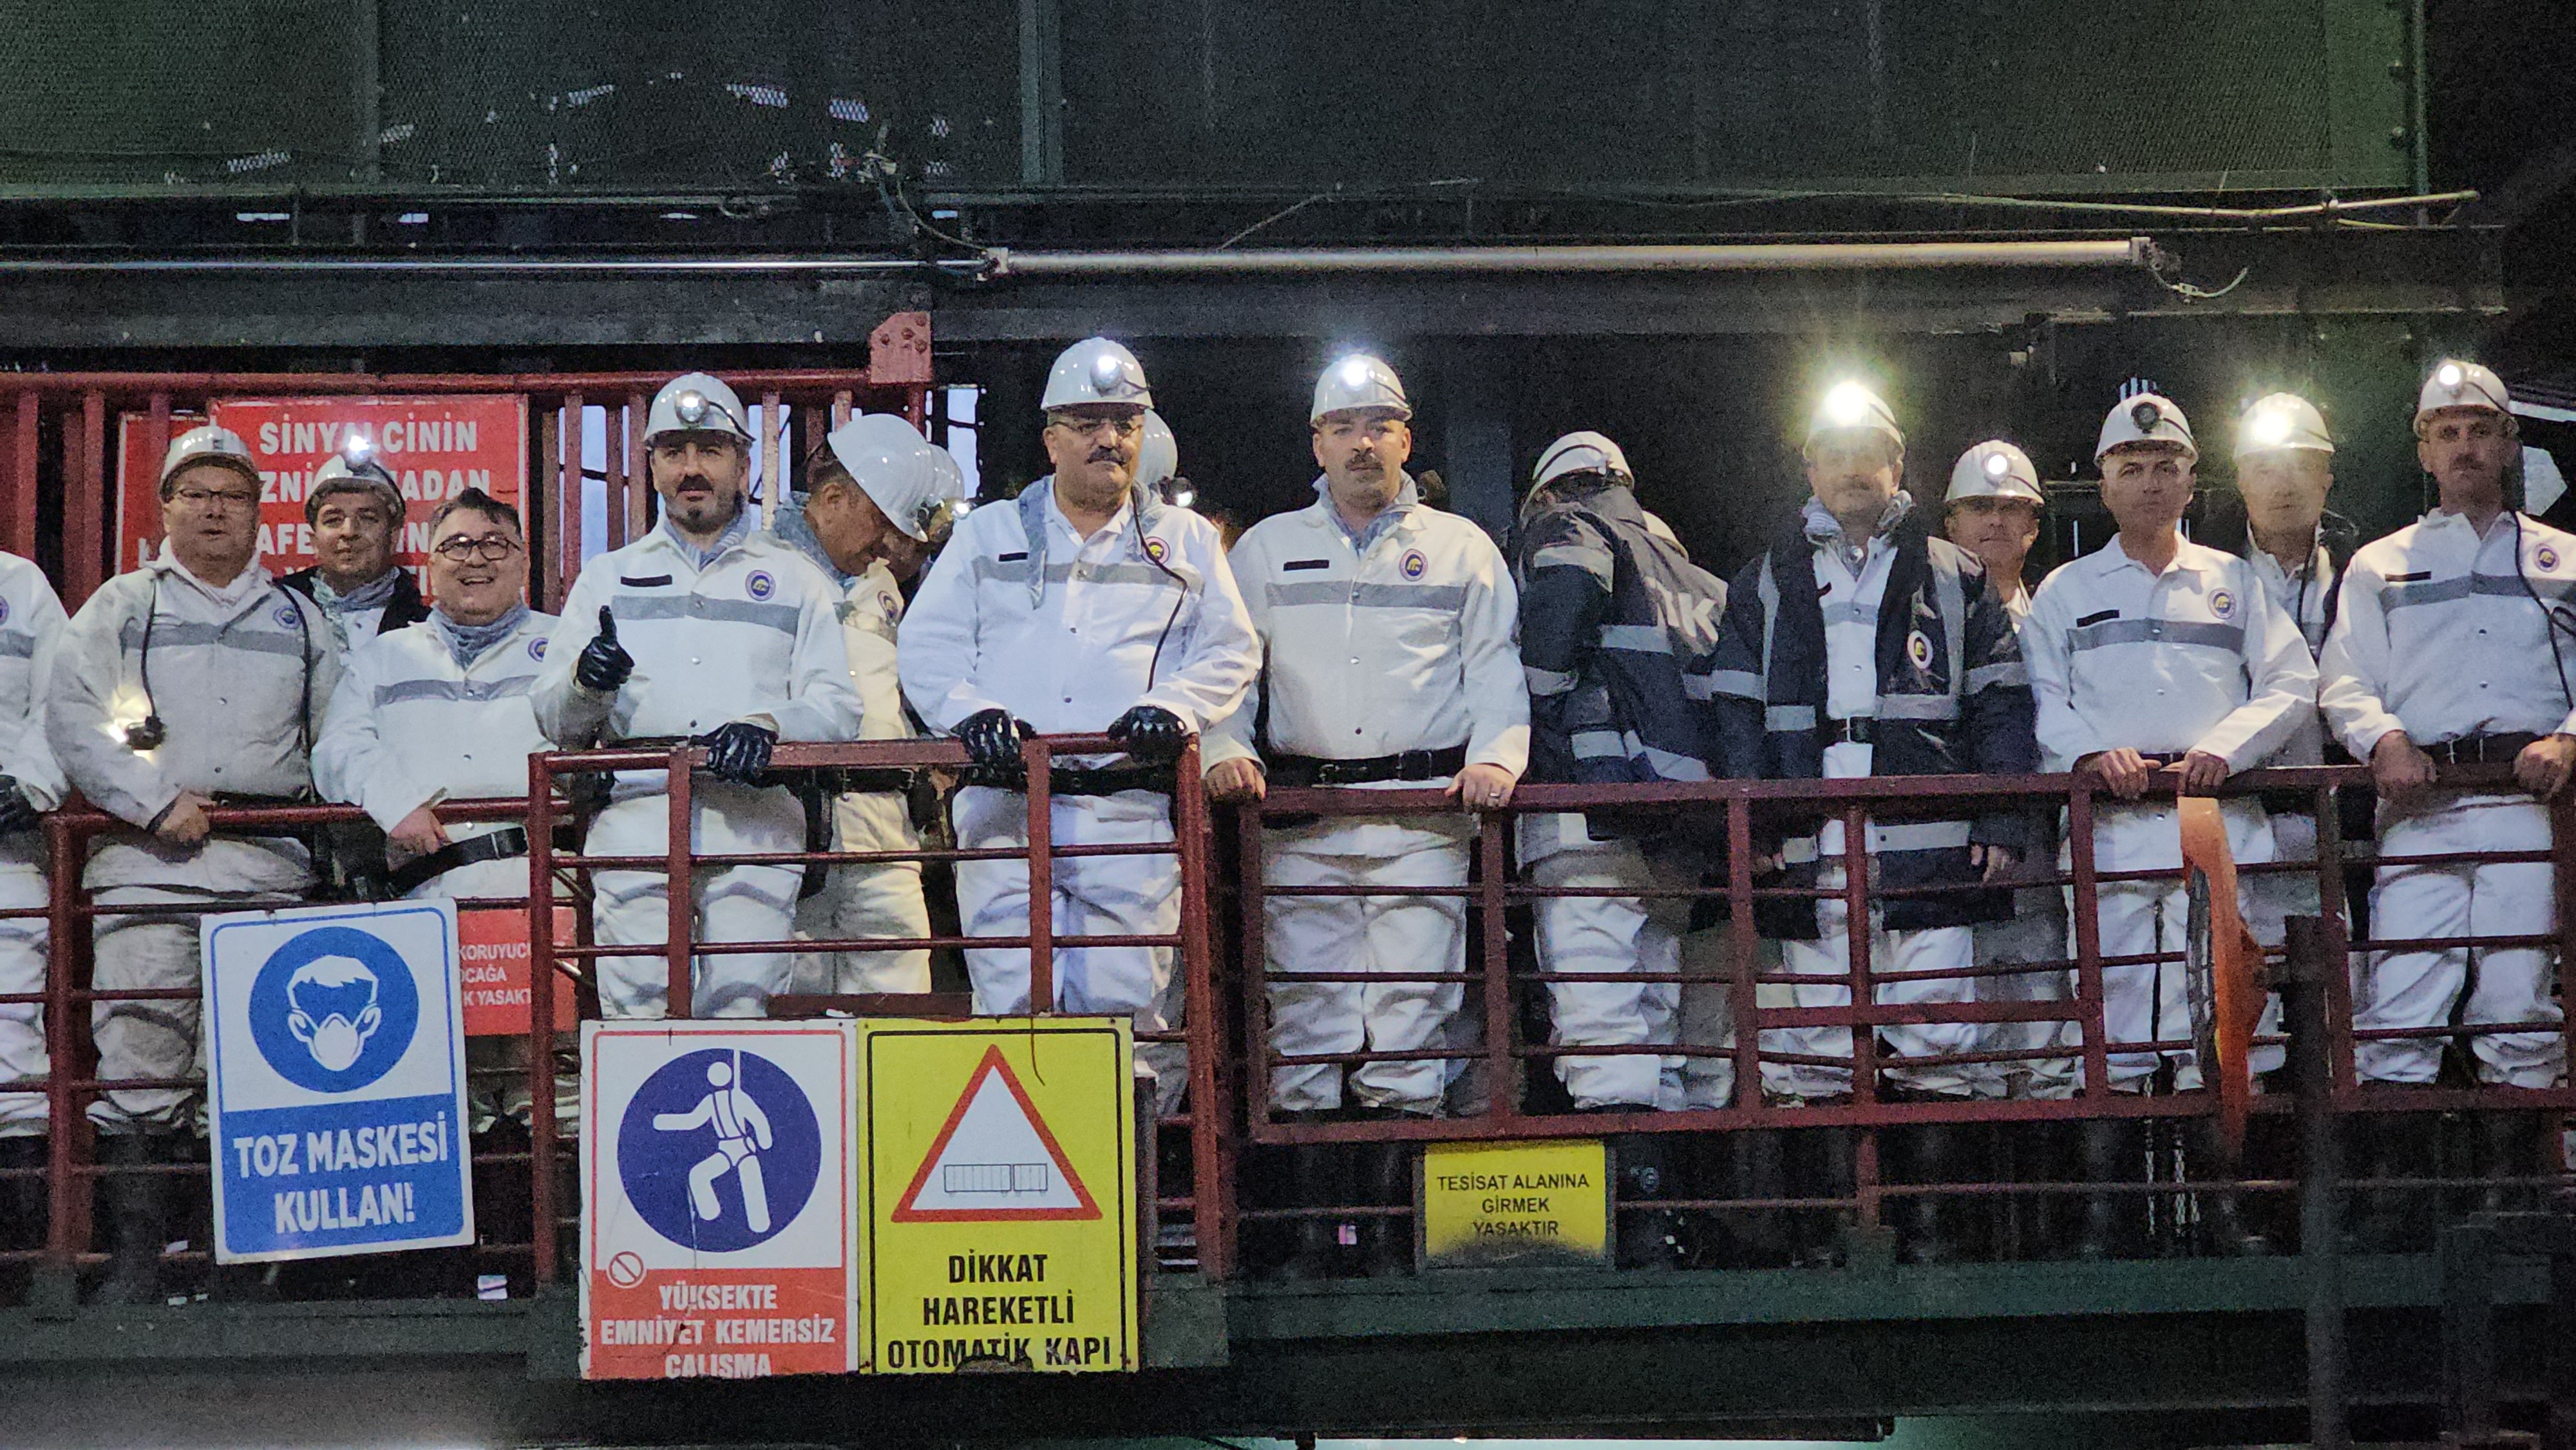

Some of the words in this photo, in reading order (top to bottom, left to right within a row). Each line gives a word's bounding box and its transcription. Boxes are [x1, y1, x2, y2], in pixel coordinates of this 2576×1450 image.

[260, 413, 477, 455] SİNYALCİNİN
[258, 462, 314, 504] ZNİ
[394, 469, 490, 501] ADAN
[459, 942, 531, 961] KORUYUC
[477, 988, 531, 1006] YASAKT
[233, 1133, 299, 1178] TOZ
[307, 1111, 448, 1173] MASKESİ
[1437, 1172, 1508, 1191] TESİSAT
[1513, 1173, 1590, 1190] ALANINA
[274, 1182, 415, 1234] KULLAN!
[1482, 1195, 1550, 1214] GİRMEK
[1472, 1220, 1559, 1237] YASAKTIR
[949, 1248, 1048, 1283] DİKKAT
[659, 1280, 778, 1310] YÜKSEKTE
[923, 1288, 1074, 1326] HAREKETLİ
[600, 1315, 706, 1344] EMNİYET
[715, 1313, 836, 1344] KEMERSİZ
[887, 1332, 1031, 1368] OTOMATİK
[1045, 1336, 1111, 1366] KAPI
